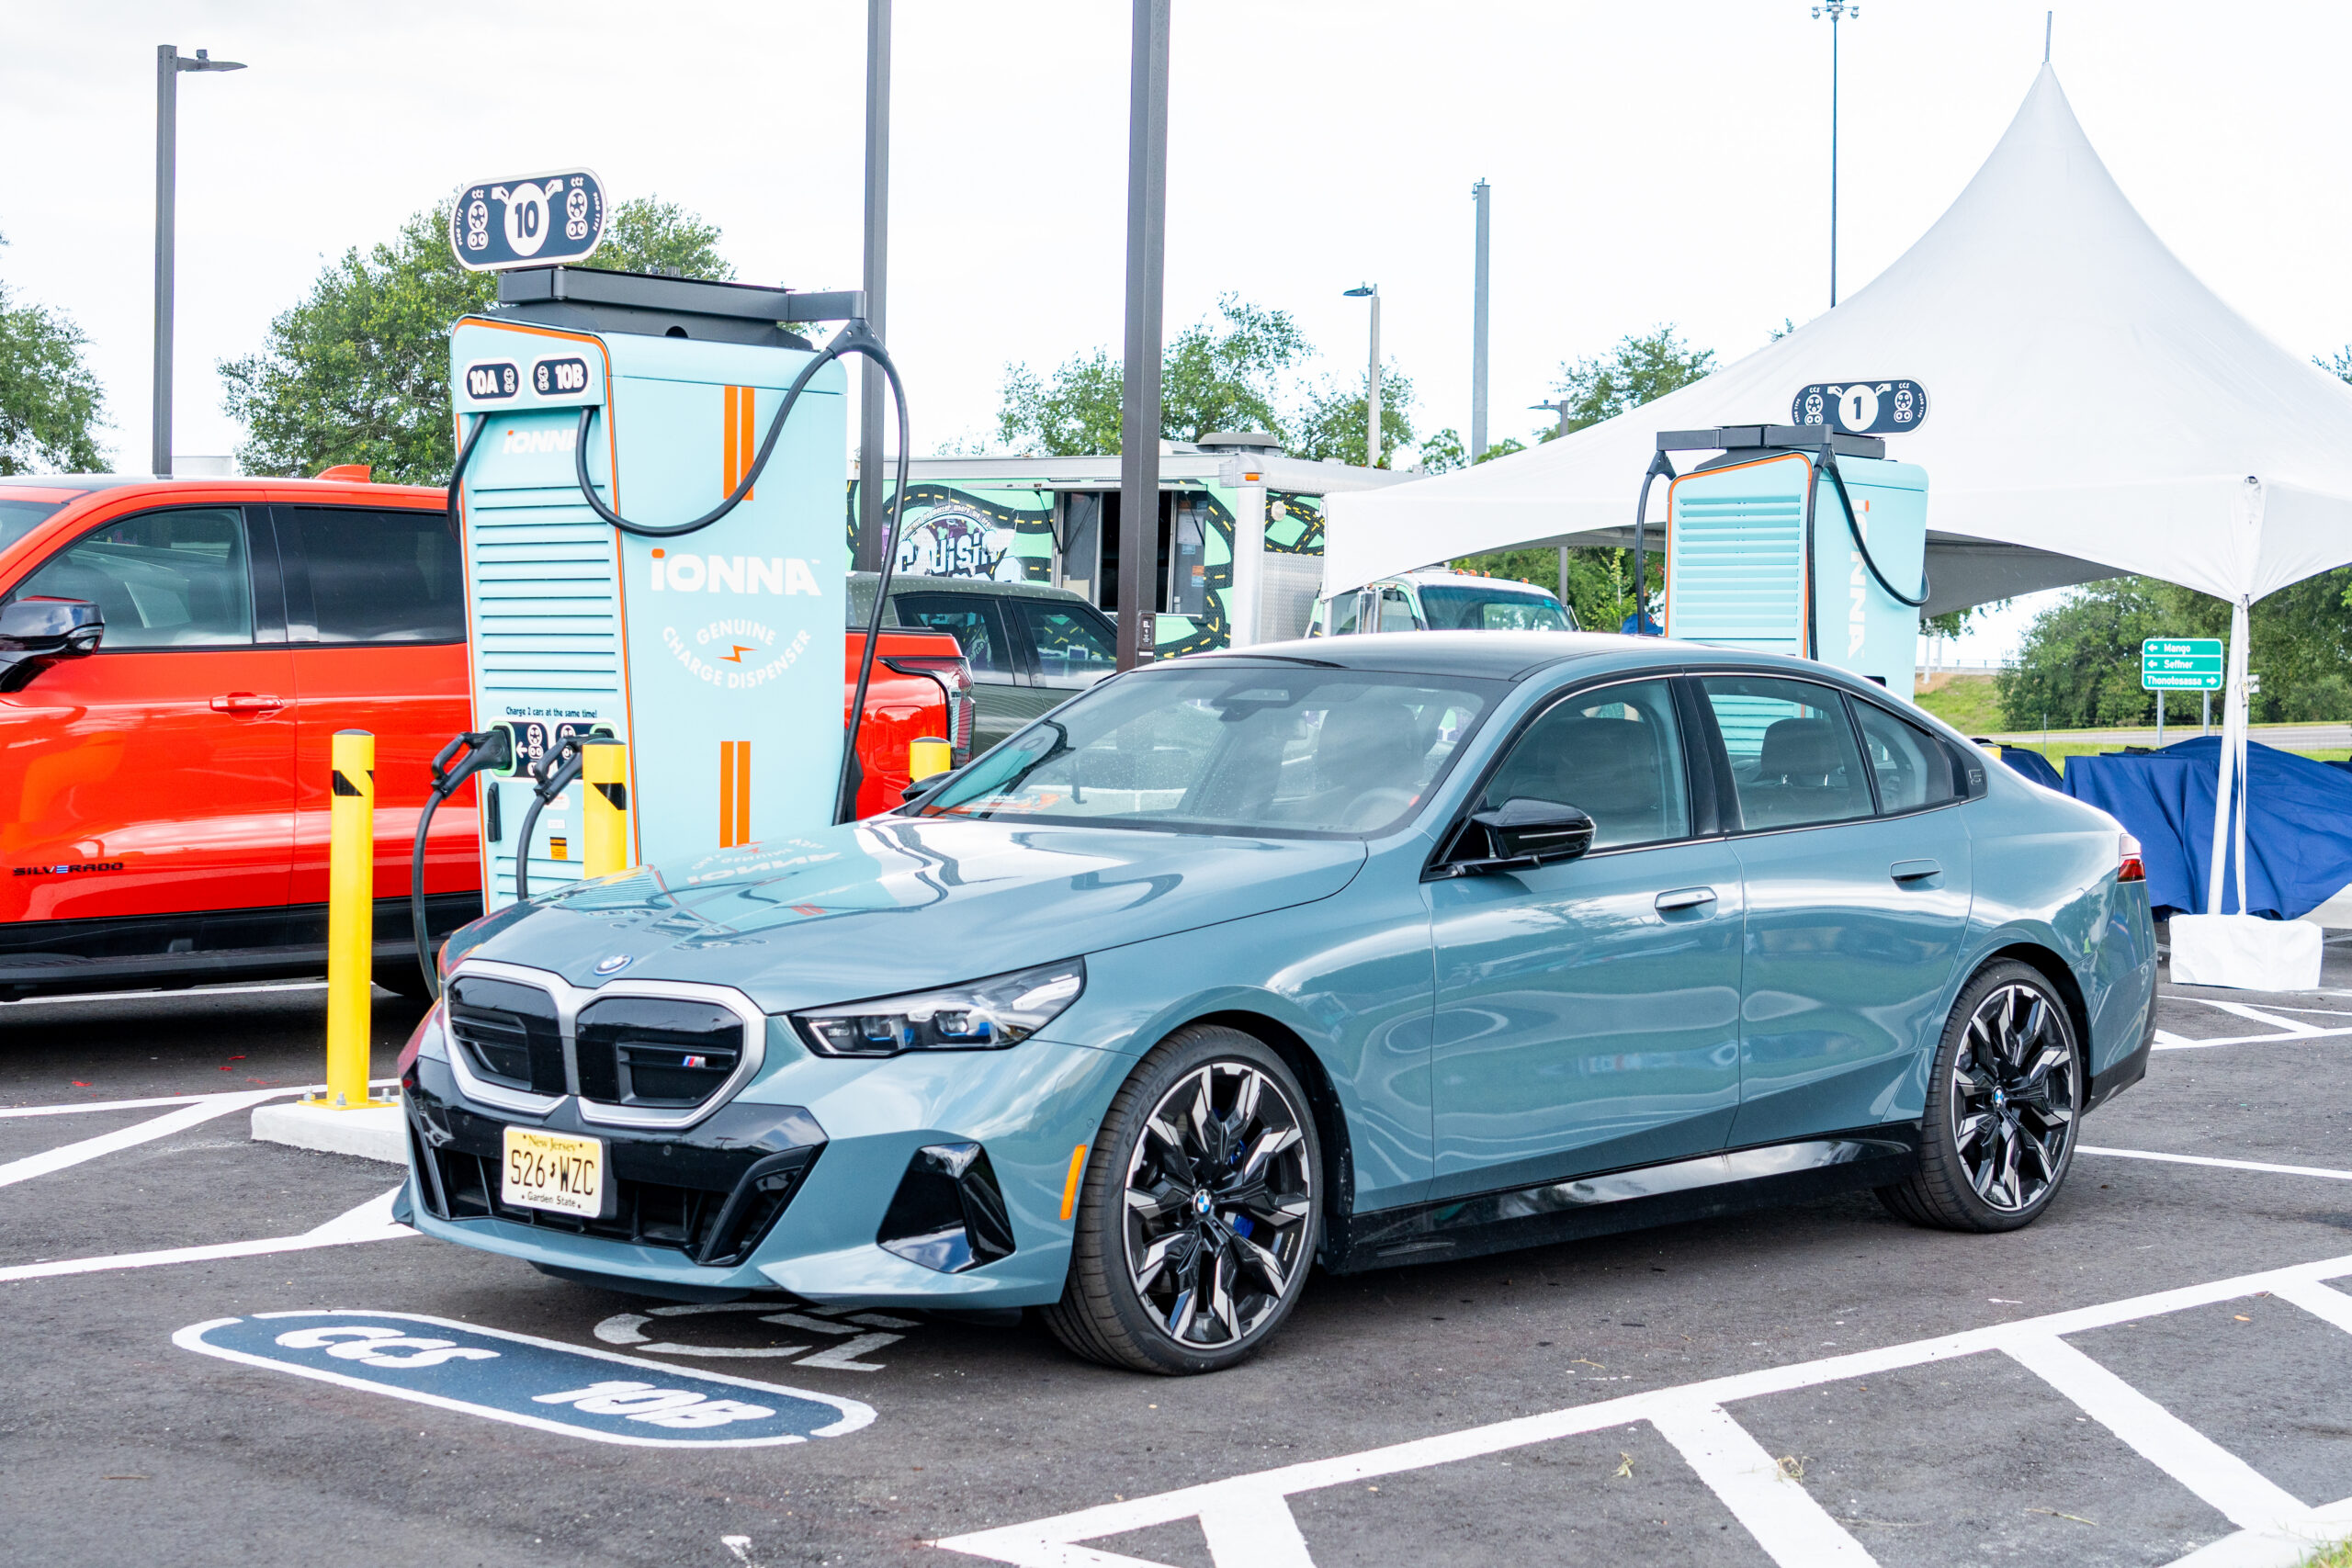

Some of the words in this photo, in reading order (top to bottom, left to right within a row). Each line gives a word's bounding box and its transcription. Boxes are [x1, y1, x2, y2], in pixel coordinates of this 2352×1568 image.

[571, 176, 583, 187] CCS
[471, 189, 484, 199] CCS
[515, 200, 539, 239] 10
[469, 369, 499, 395] 10A
[555, 363, 584, 389] 10B
[1853, 396, 1862, 420] 1
[696, 618, 777, 646] GENUINE
[662, 626, 723, 686] CHARGE
[728, 629, 811, 689] DISPENSER
[2164, 643, 2191, 655] Mango
[2164, 660, 2194, 669] Seffner
[2146, 675, 2202, 685] Thonotosassa
[506, 706, 526, 716] Charge
[527, 706, 531, 716] 2
[546, 708, 551, 716] at
[553, 708, 563, 717] the
[582, 709, 597, 718] time!
[13, 863, 124, 875] SILVERADO
[528, 1134, 548, 1147] New
[549, 1137, 576, 1152] Jersey
[511, 1149, 546, 1188] S26
[560, 1155, 594, 1196] WZC
[527, 1191, 553, 1203] Garden
[556, 1195, 576, 1207] State
[276, 1325, 501, 1369] CCS
[532, 1381, 776, 1428] 10B
